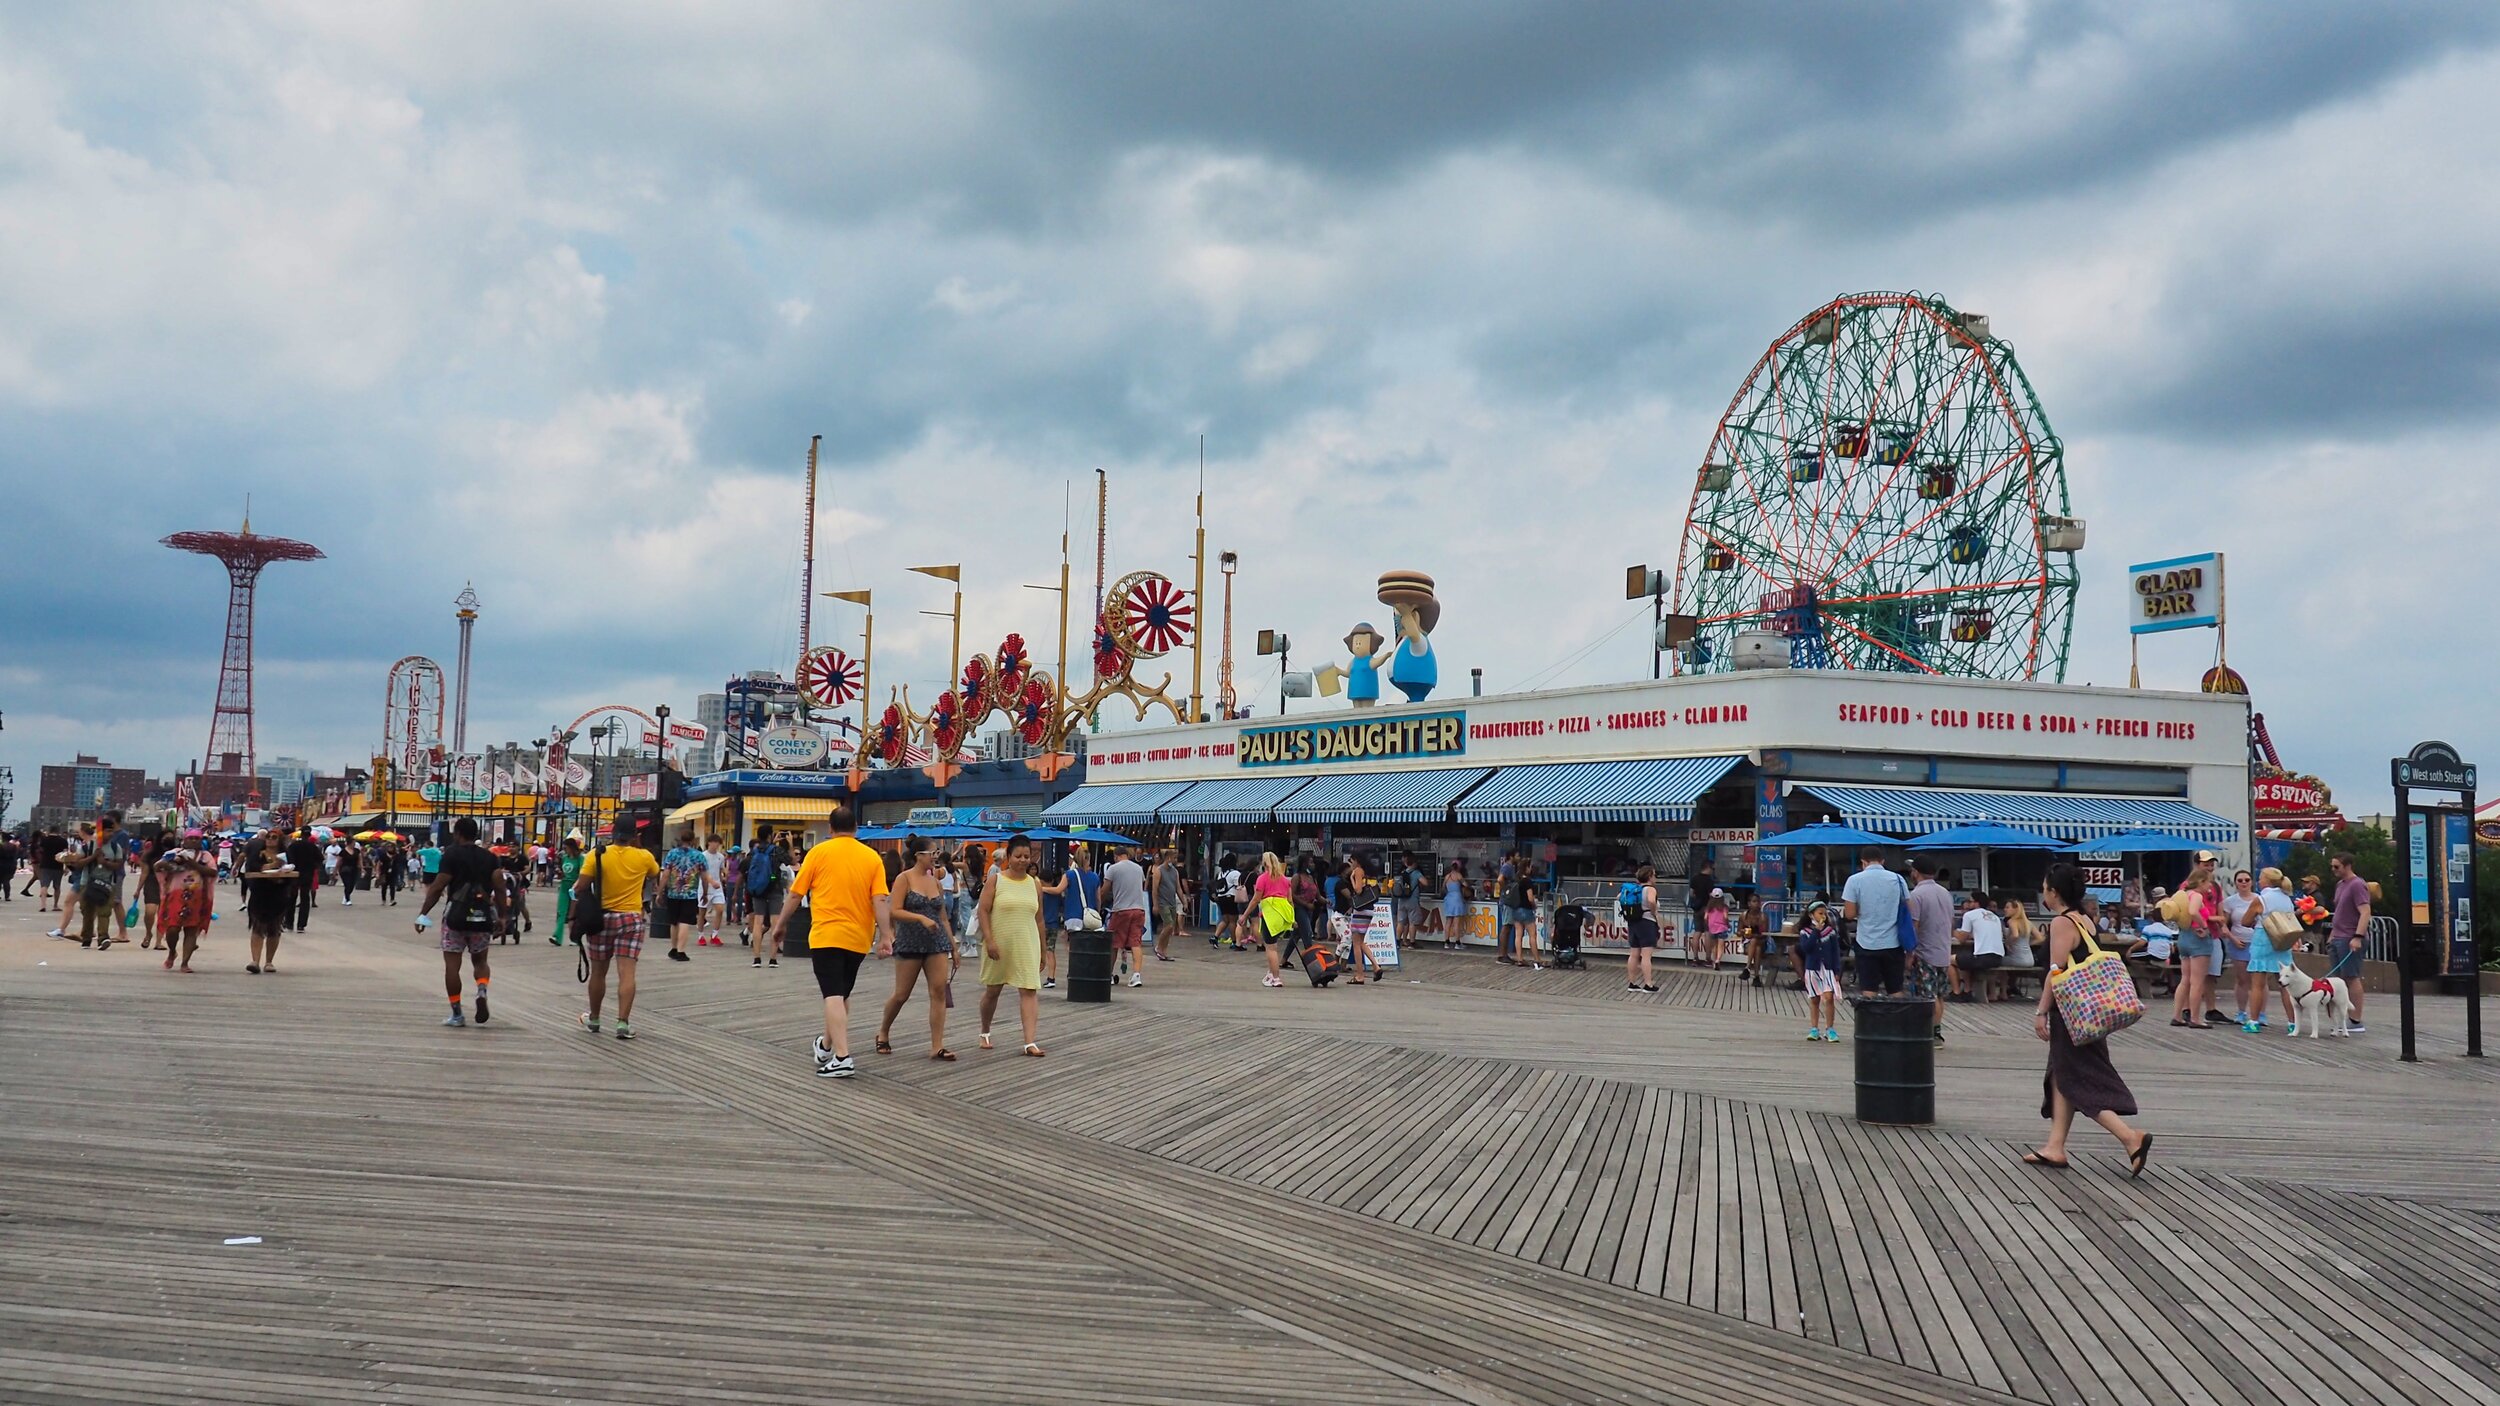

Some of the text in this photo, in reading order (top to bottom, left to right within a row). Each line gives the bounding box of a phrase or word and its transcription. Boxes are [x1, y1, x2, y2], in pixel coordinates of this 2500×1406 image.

[2135, 567, 2202, 595] CLAM
[2143, 592, 2196, 617] BAR
[410, 672, 421, 788] THUNDERBOLT
[1470, 704, 1748, 739] FRANKFURTERS PIZZA SAUSAGES CLAM BAR
[1839, 703, 2196, 740] SEAFOOD COLD BEER & SODA FRENCH FRIES
[671, 726, 704, 740] FAMIGLIA
[1237, 717, 1461, 764] PAUL'S DAUGHTER
[769, 739, 817, 749] CONEY'S
[773, 748, 812, 756] CONES
[1090, 743, 1235, 766] FRIES COLD BEER COTTON CANDY ICE CREAM
[2411, 767, 2465, 784] West 10th Street
[2271, 784, 2322, 807] SWING
[1760, 804, 1783, 818] CLAMS
[1690, 830, 1755, 842] CLAM BAR
[2082, 868, 2121, 884] BEER
[1378, 920, 1392, 928] Bar
